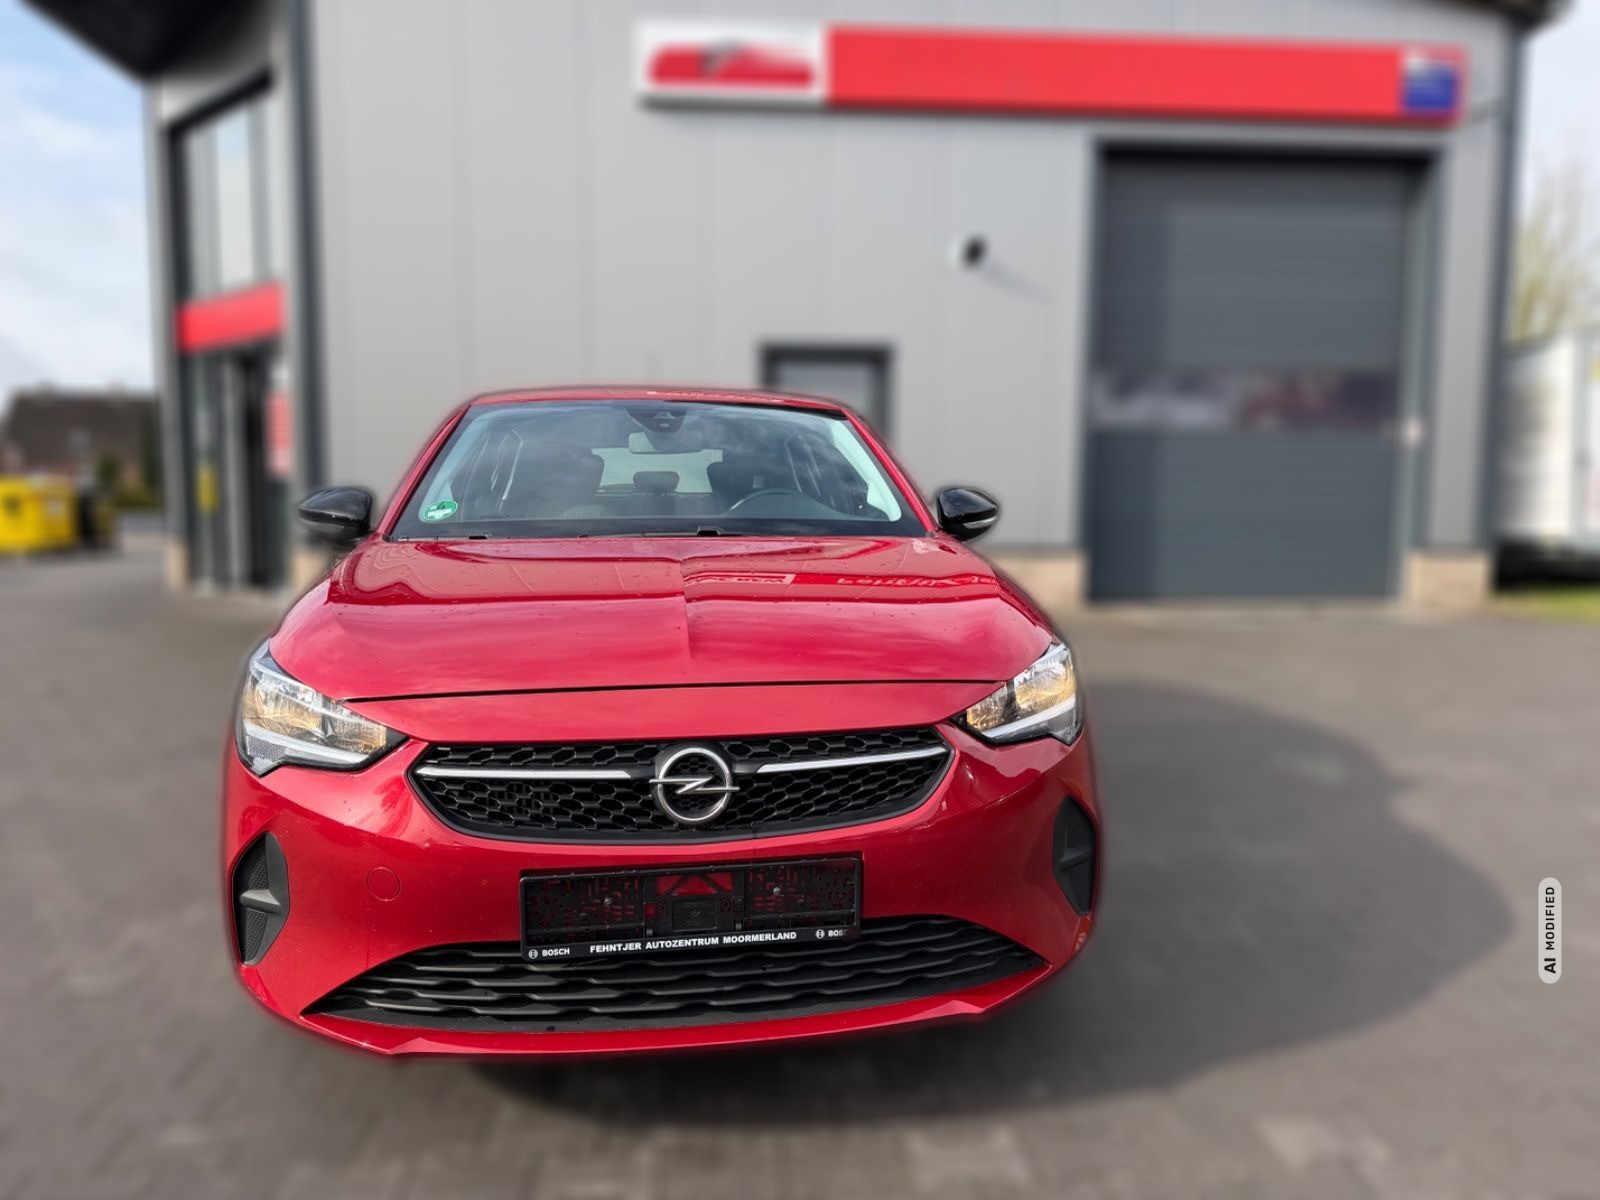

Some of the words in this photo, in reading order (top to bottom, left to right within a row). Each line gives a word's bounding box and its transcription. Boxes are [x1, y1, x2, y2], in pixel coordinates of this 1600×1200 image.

[589, 942, 642, 953] FEHNTJER
[645, 936, 719, 950] AUTOZENTRUM
[722, 931, 797, 944] MOORMERLAND
[542, 948, 570, 957] BOSCH
